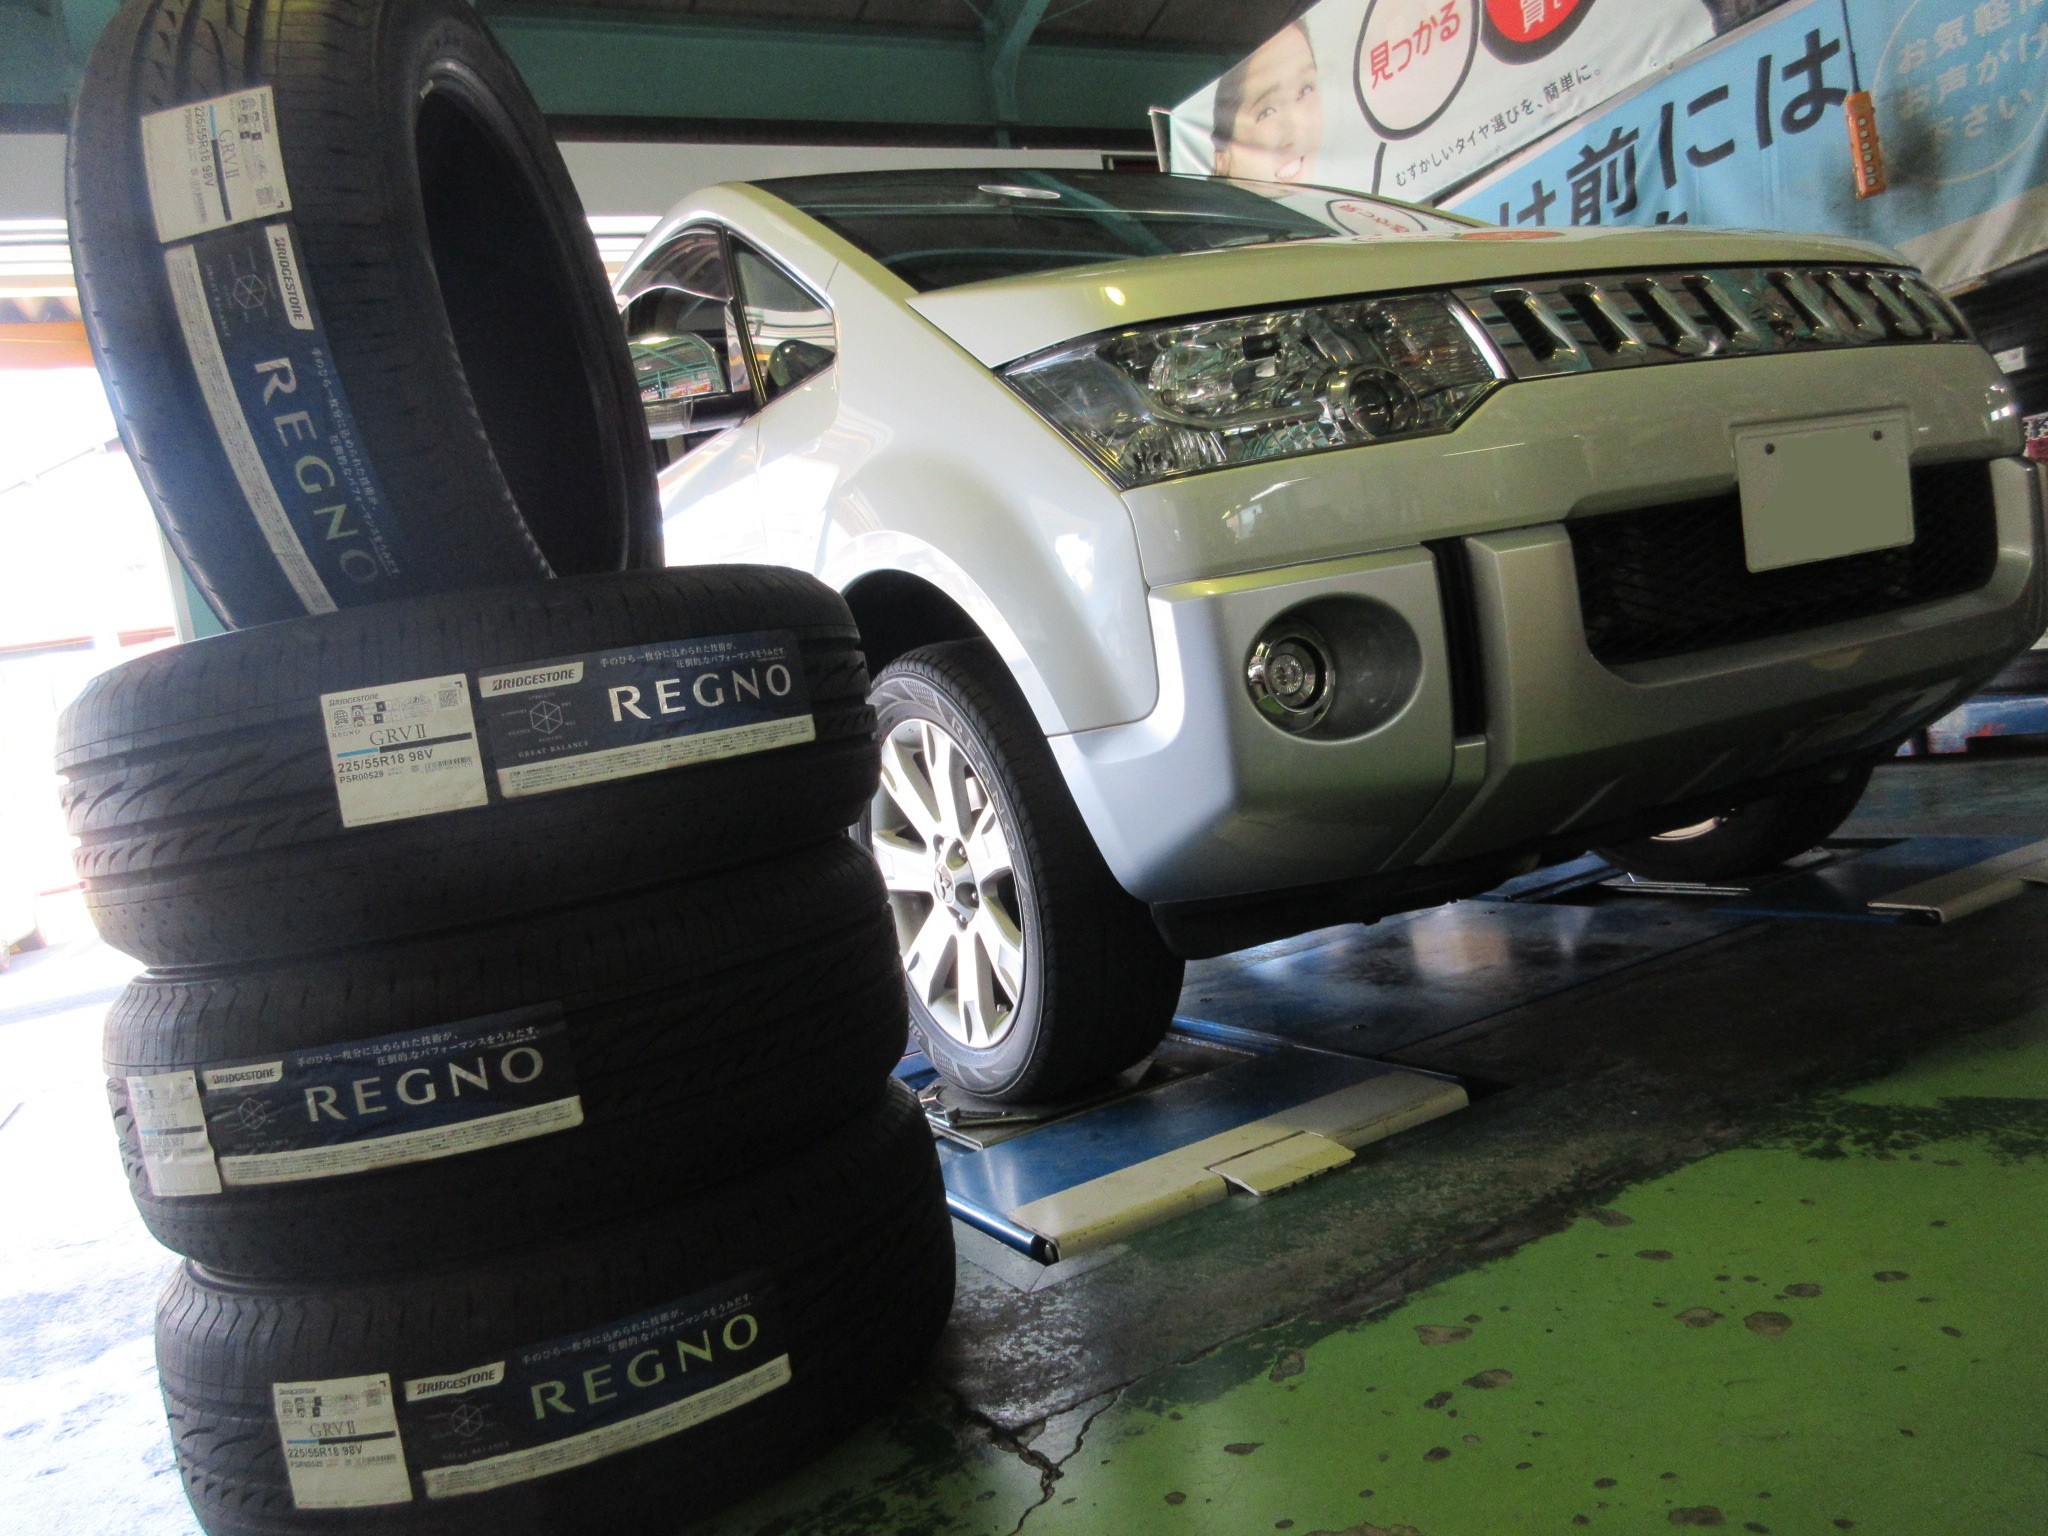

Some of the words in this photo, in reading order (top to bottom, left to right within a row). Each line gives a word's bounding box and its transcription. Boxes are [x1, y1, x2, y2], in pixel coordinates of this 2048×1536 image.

[1370, 0, 1461, 90] 見つかる
[273, 236, 305, 321] BRIDGESTONE
[254, 358, 380, 584] REGNO
[492, 669, 575, 691] BRIDGESTONE
[608, 664, 791, 722] REGNO
[338, 754, 405, 773] 225/55R18
[409, 749, 433, 762] 98V
[212, 1068, 276, 1084] BRIDGESTONE
[304, 1047, 544, 1122] REGNO
[417, 1370, 496, 1395] BRIDGESTONE
[530, 1313, 758, 1420] REGNO
